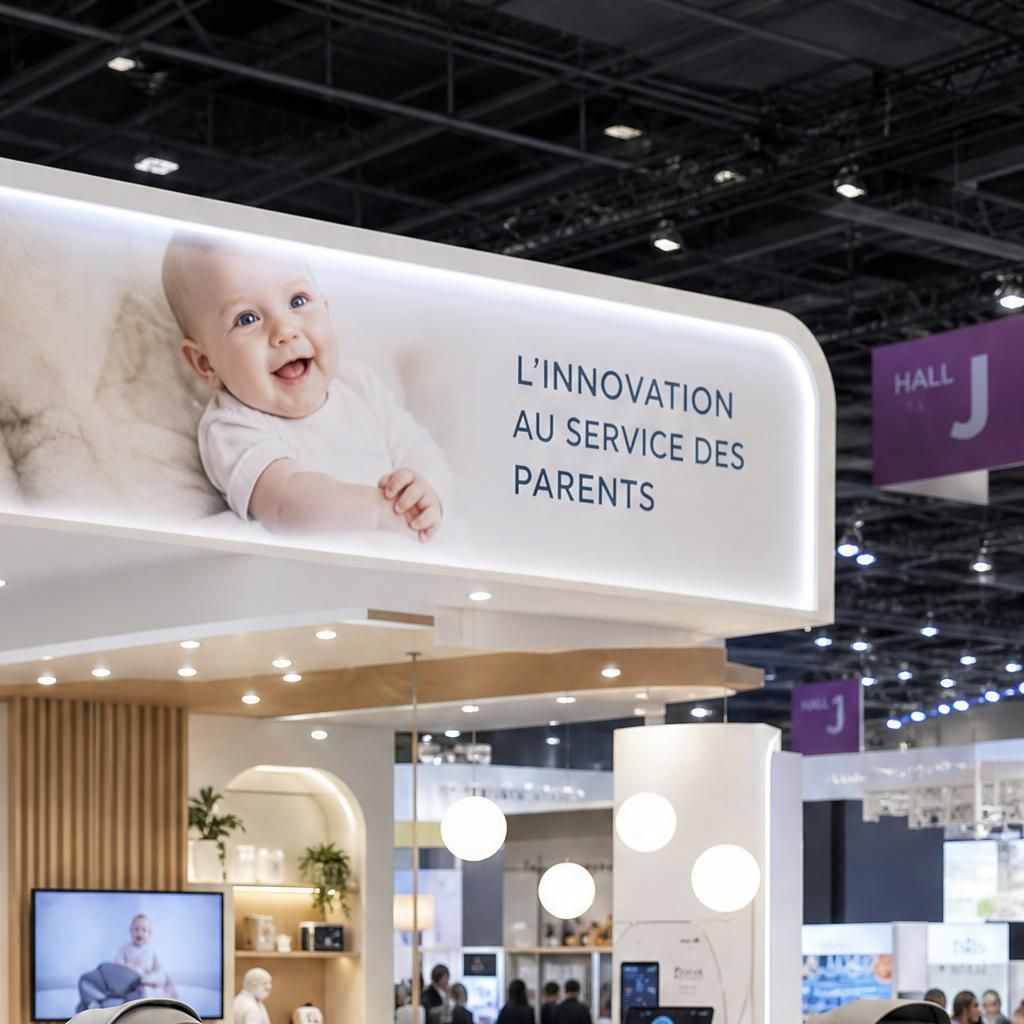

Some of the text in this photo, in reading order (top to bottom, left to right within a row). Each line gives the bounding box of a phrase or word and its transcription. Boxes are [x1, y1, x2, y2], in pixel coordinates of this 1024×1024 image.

[894, 353, 989, 441] HALL J
[512, 410, 745, 471] AU SERVICE DES
[514, 464, 655, 512] PARENTS
[825, 694, 845, 736] J
